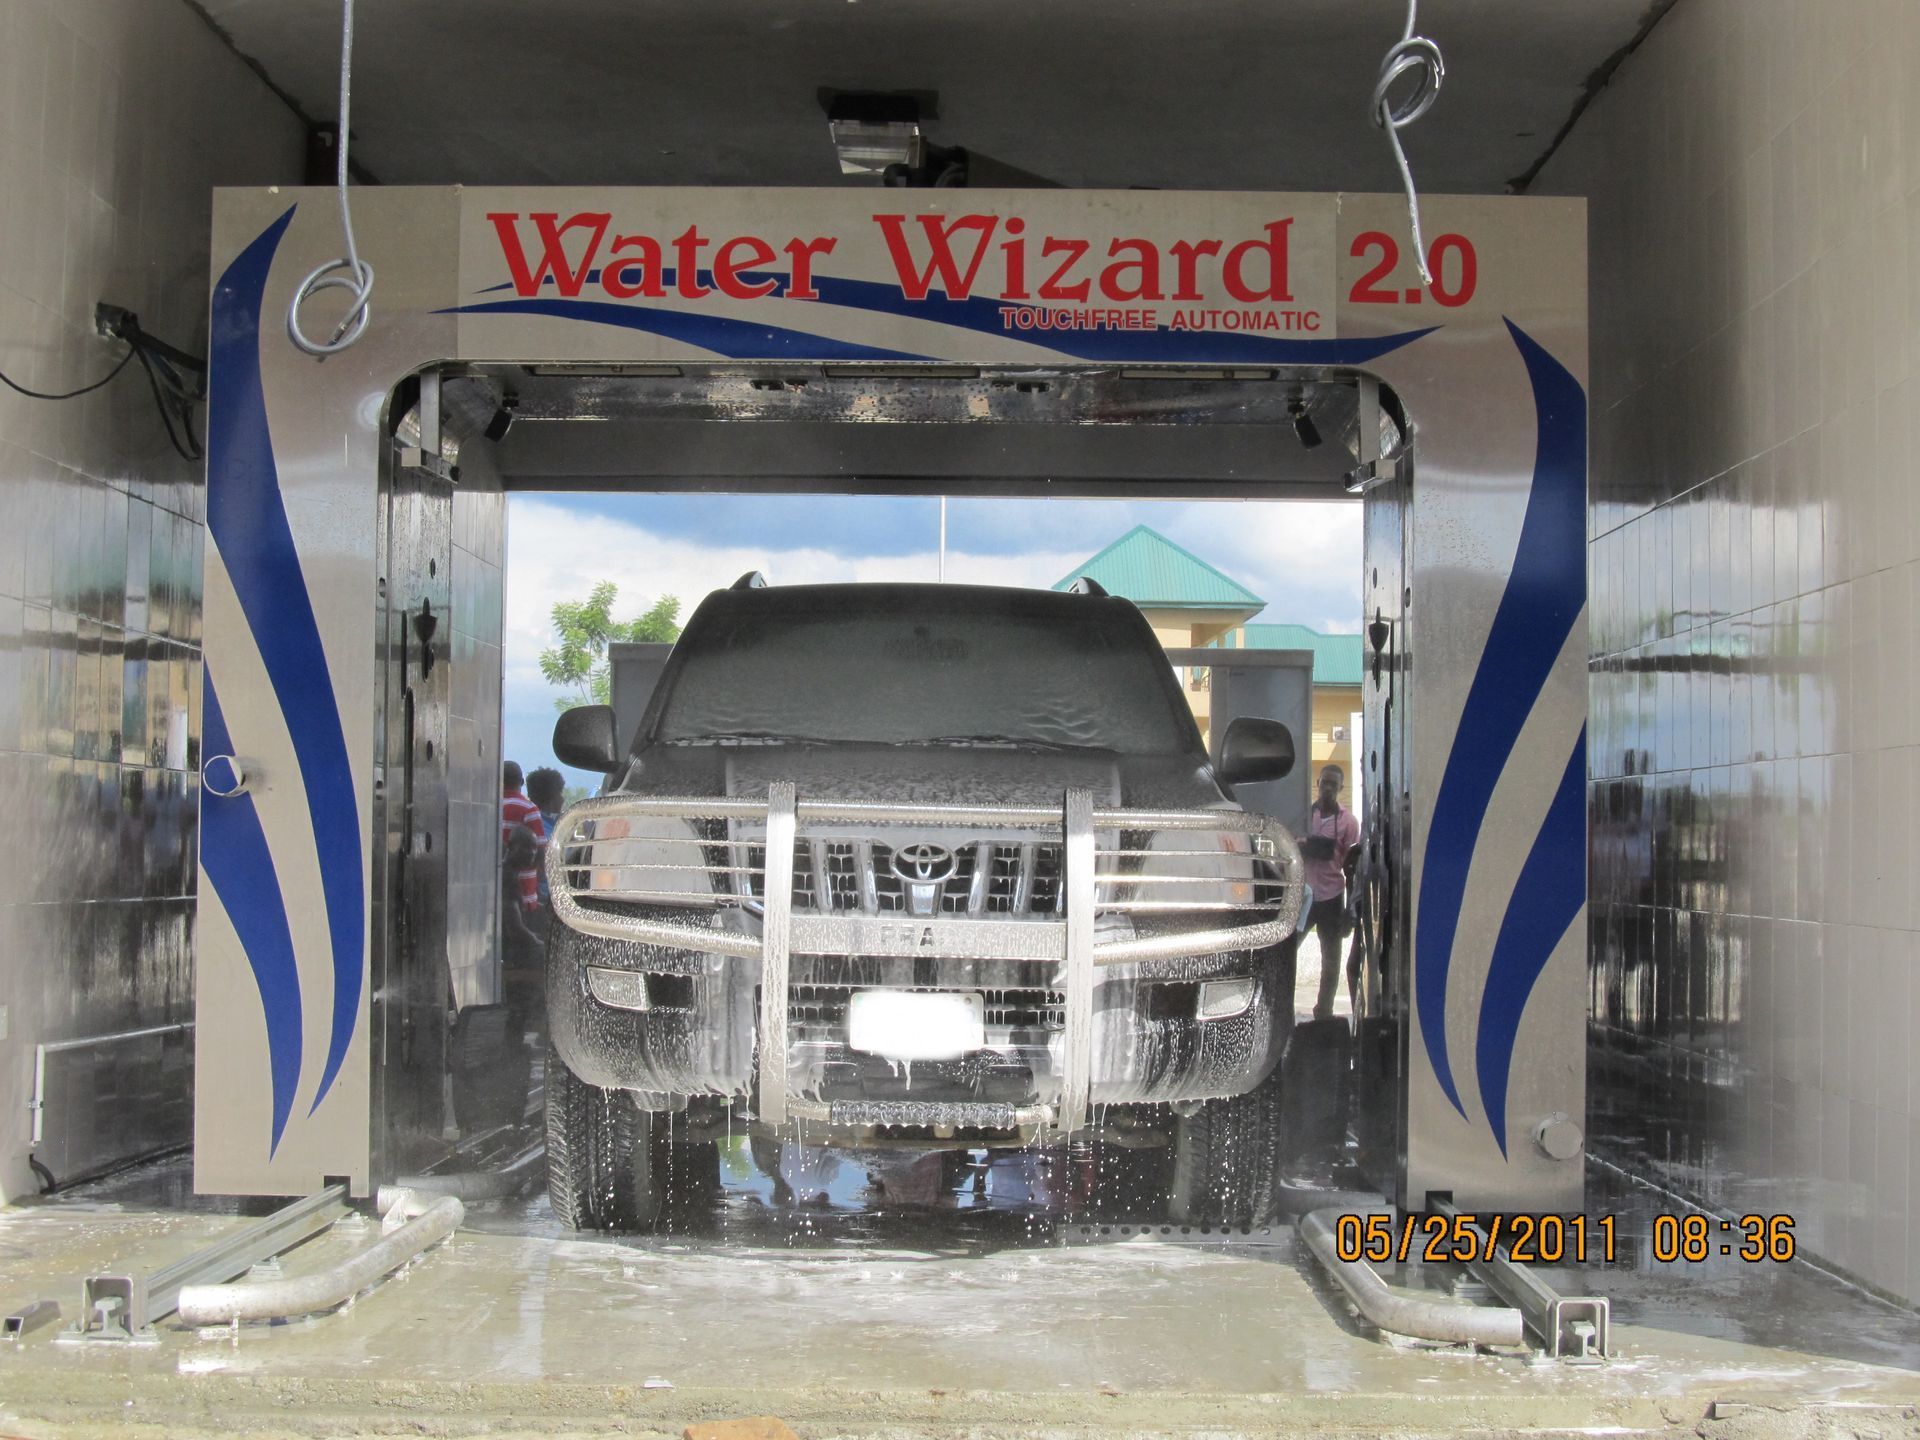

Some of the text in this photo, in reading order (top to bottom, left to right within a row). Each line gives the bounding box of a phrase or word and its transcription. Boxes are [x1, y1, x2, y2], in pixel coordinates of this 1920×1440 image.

[488, 213, 1476, 307] Water Wizard 2.0
[1000, 308, 1321, 331] TOUCHFREE AUTOMATIC
